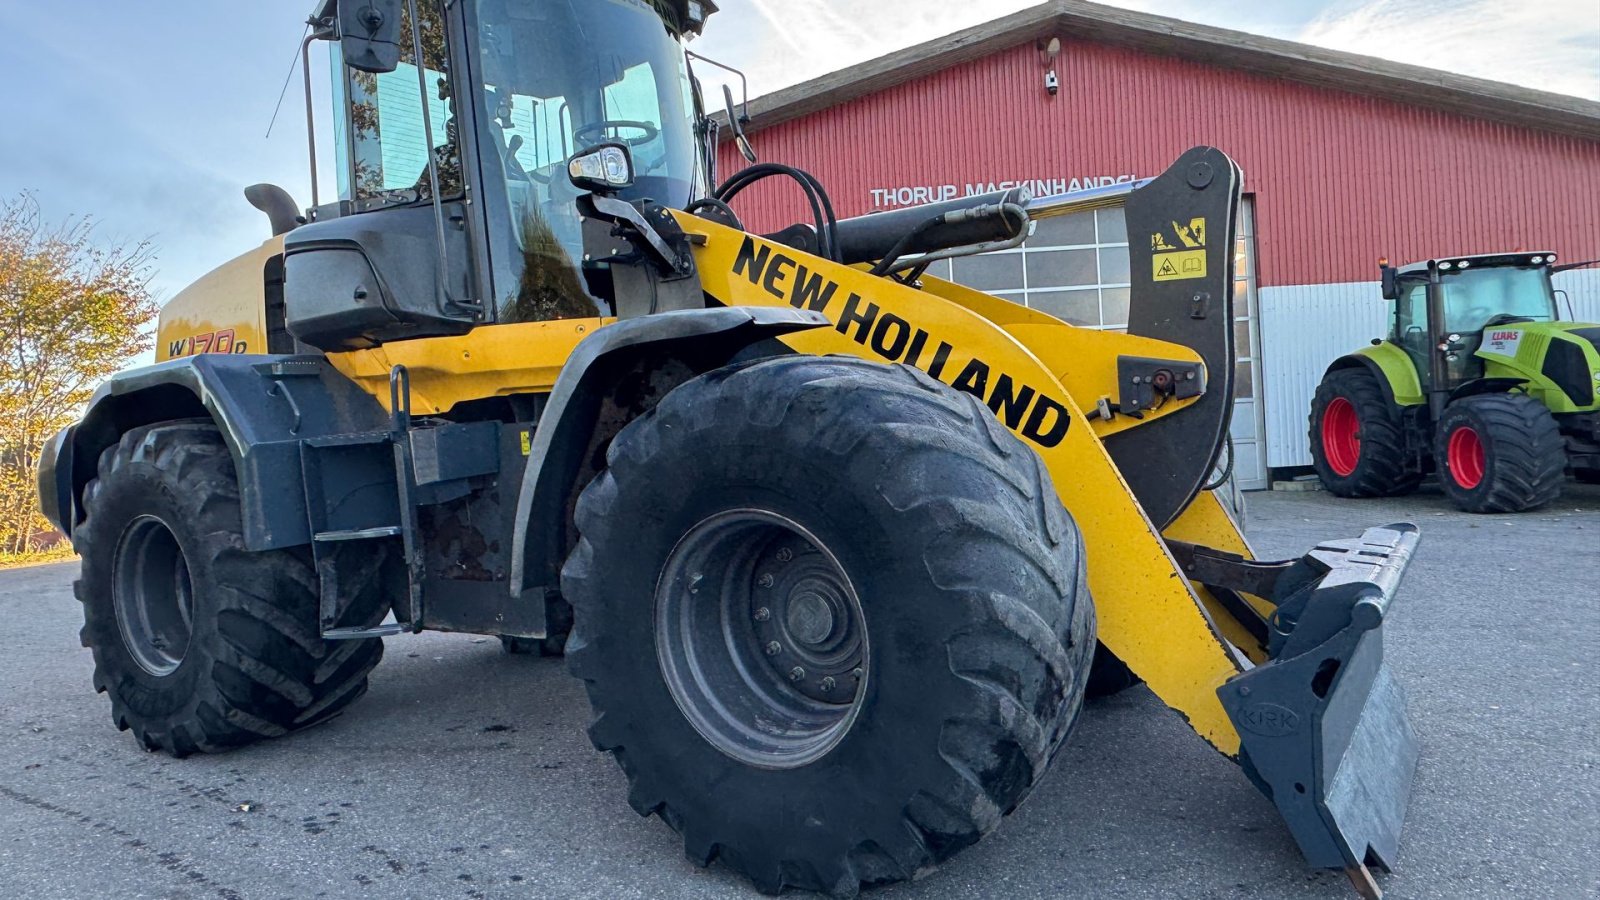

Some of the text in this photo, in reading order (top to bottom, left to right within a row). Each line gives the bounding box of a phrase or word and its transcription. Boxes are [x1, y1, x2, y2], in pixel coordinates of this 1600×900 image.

[870, 184, 957, 207] THORUP
[732, 234, 1071, 448] NEW HOLLAND
[1492, 331, 1518, 341] CLAAS
[1243, 710, 1294, 729] KIRK
